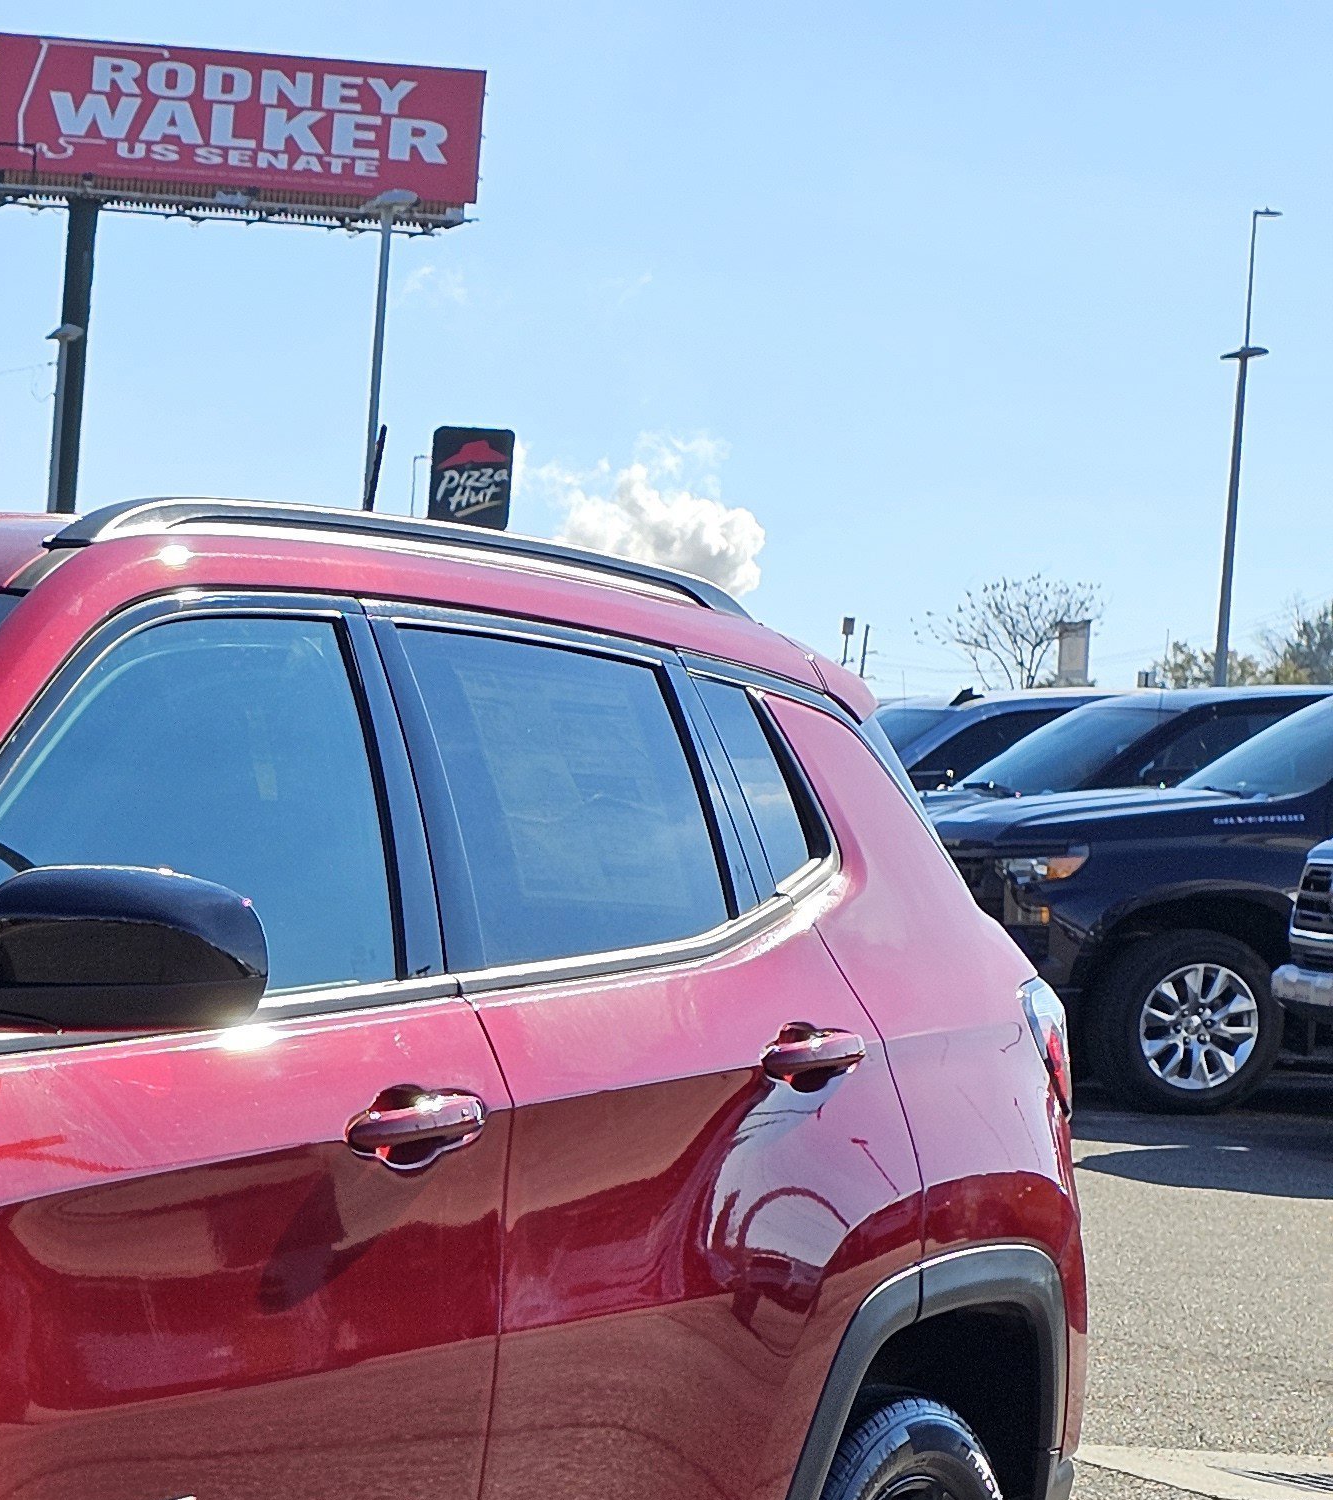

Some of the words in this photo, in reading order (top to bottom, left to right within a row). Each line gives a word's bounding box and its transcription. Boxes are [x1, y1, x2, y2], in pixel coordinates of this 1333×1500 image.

[91, 56, 418, 115] RODNEY
[49, 90, 449, 165] WALKER
[116, 141, 180, 162] US
[193, 146, 379, 178] SENATE
[435, 466, 510, 503] Pizza
[448, 483, 502, 512] Hut
